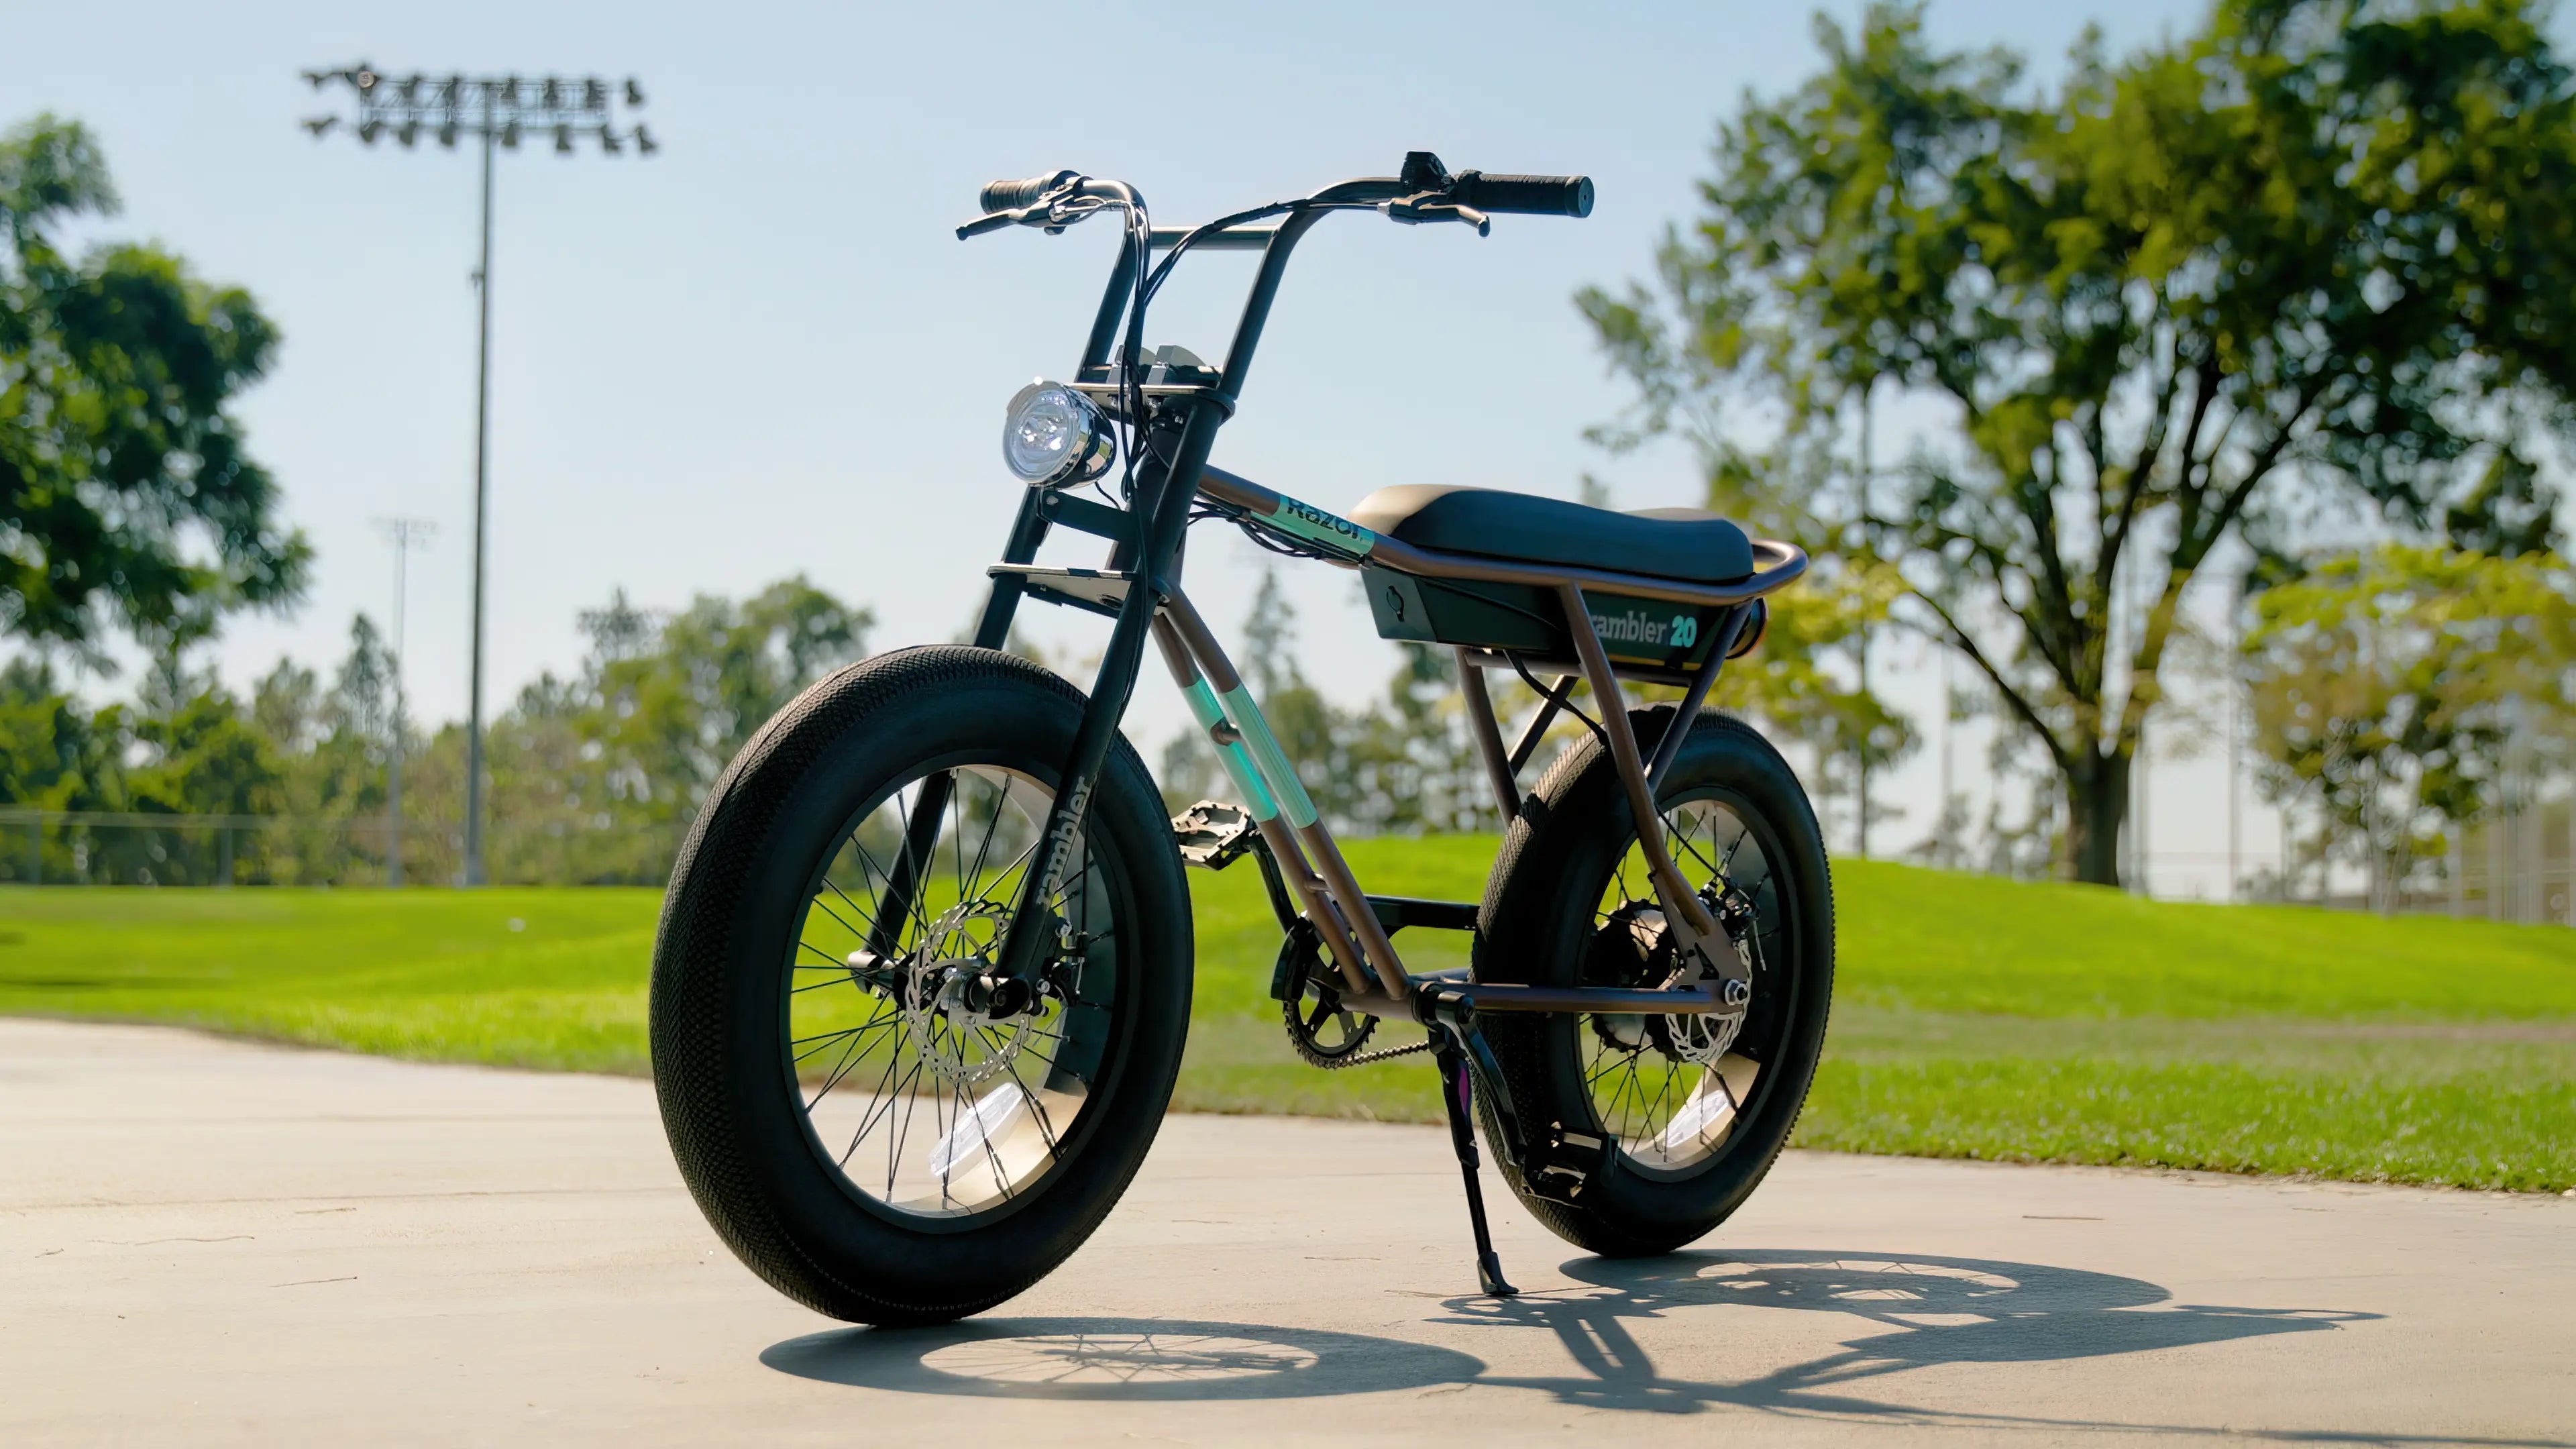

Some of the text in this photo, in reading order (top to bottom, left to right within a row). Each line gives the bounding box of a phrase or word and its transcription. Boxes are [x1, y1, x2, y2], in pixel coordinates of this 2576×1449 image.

[1287, 497, 1359, 539] Razor
[1670, 615, 1697, 648] 20
[1036, 775, 1090, 912] rambler
